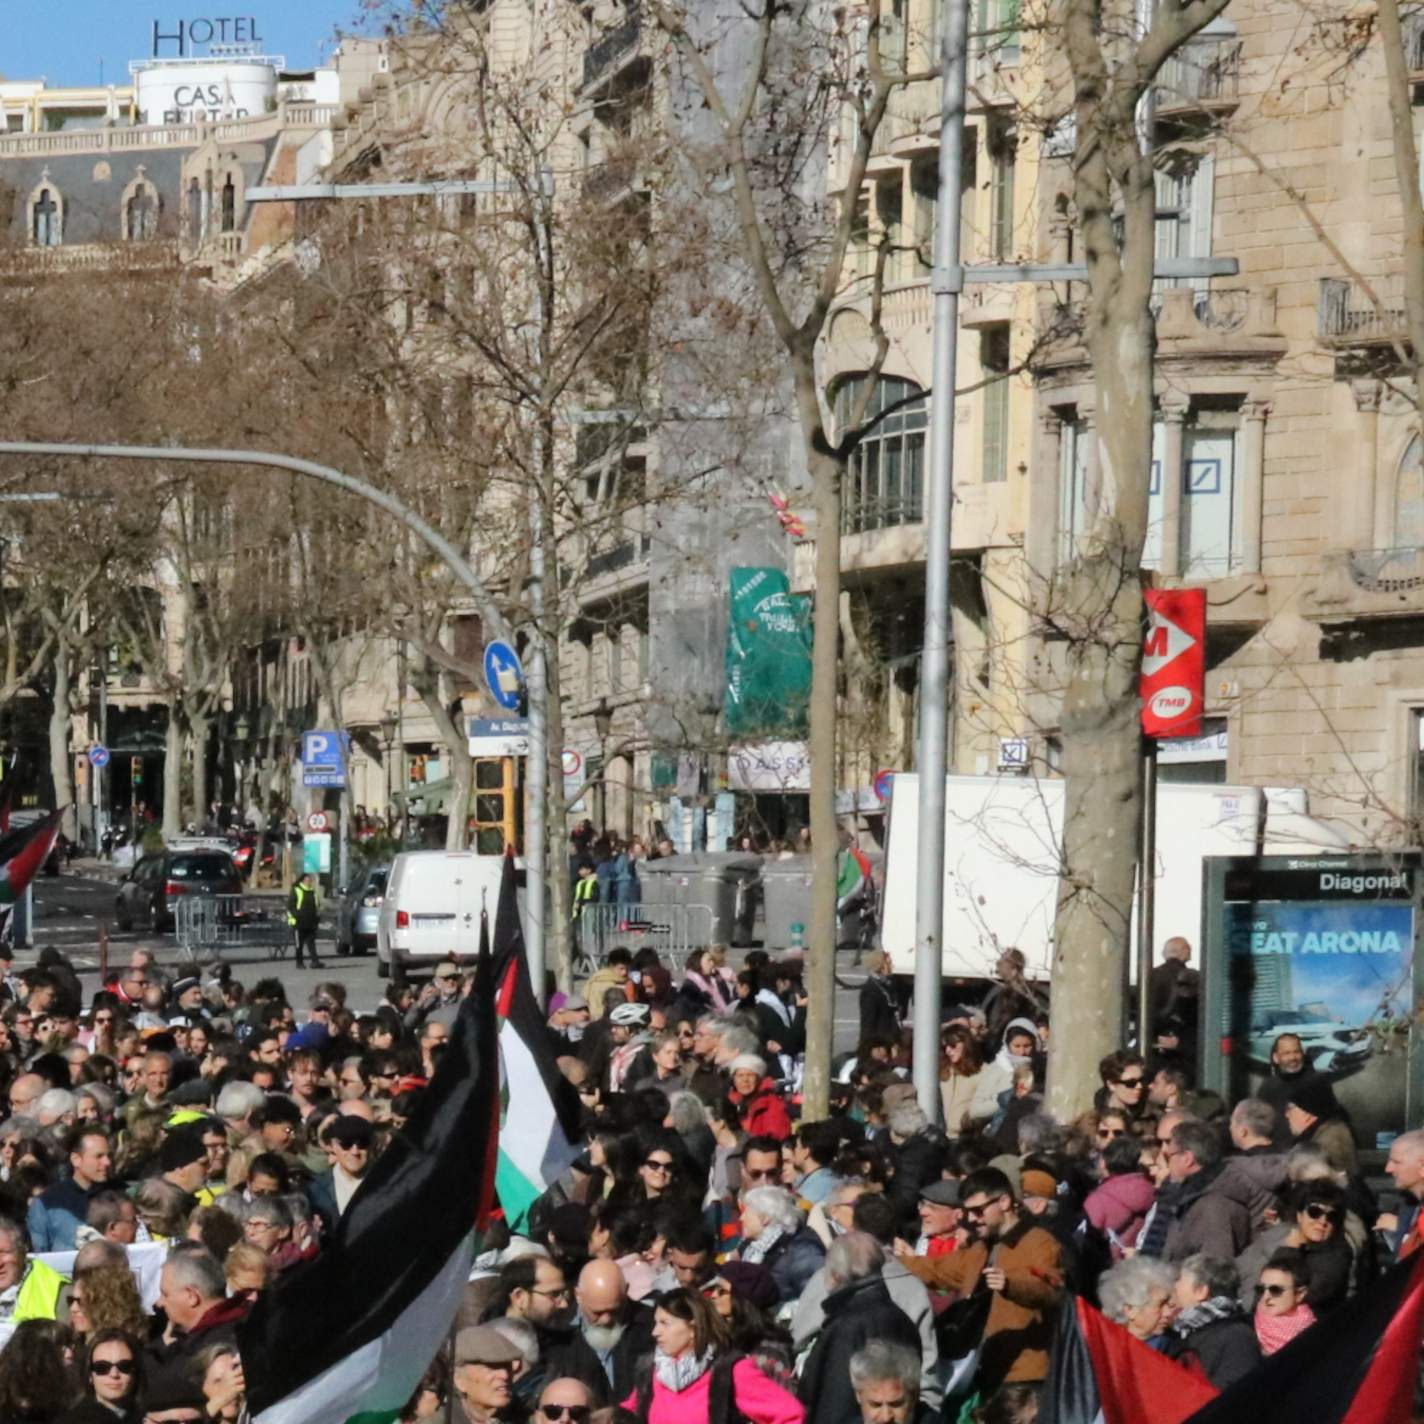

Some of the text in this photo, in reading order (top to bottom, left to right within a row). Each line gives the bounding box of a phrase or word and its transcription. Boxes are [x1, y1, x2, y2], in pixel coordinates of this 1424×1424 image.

[154, 17, 263, 56] HOTEL
[174, 86, 236, 107] CASA
[1158, 697, 1186, 709] TMB
[306, 735, 328, 762] P
[1320, 873, 1408, 893] Diagonal
[1303, 930, 1401, 954] ARONA
